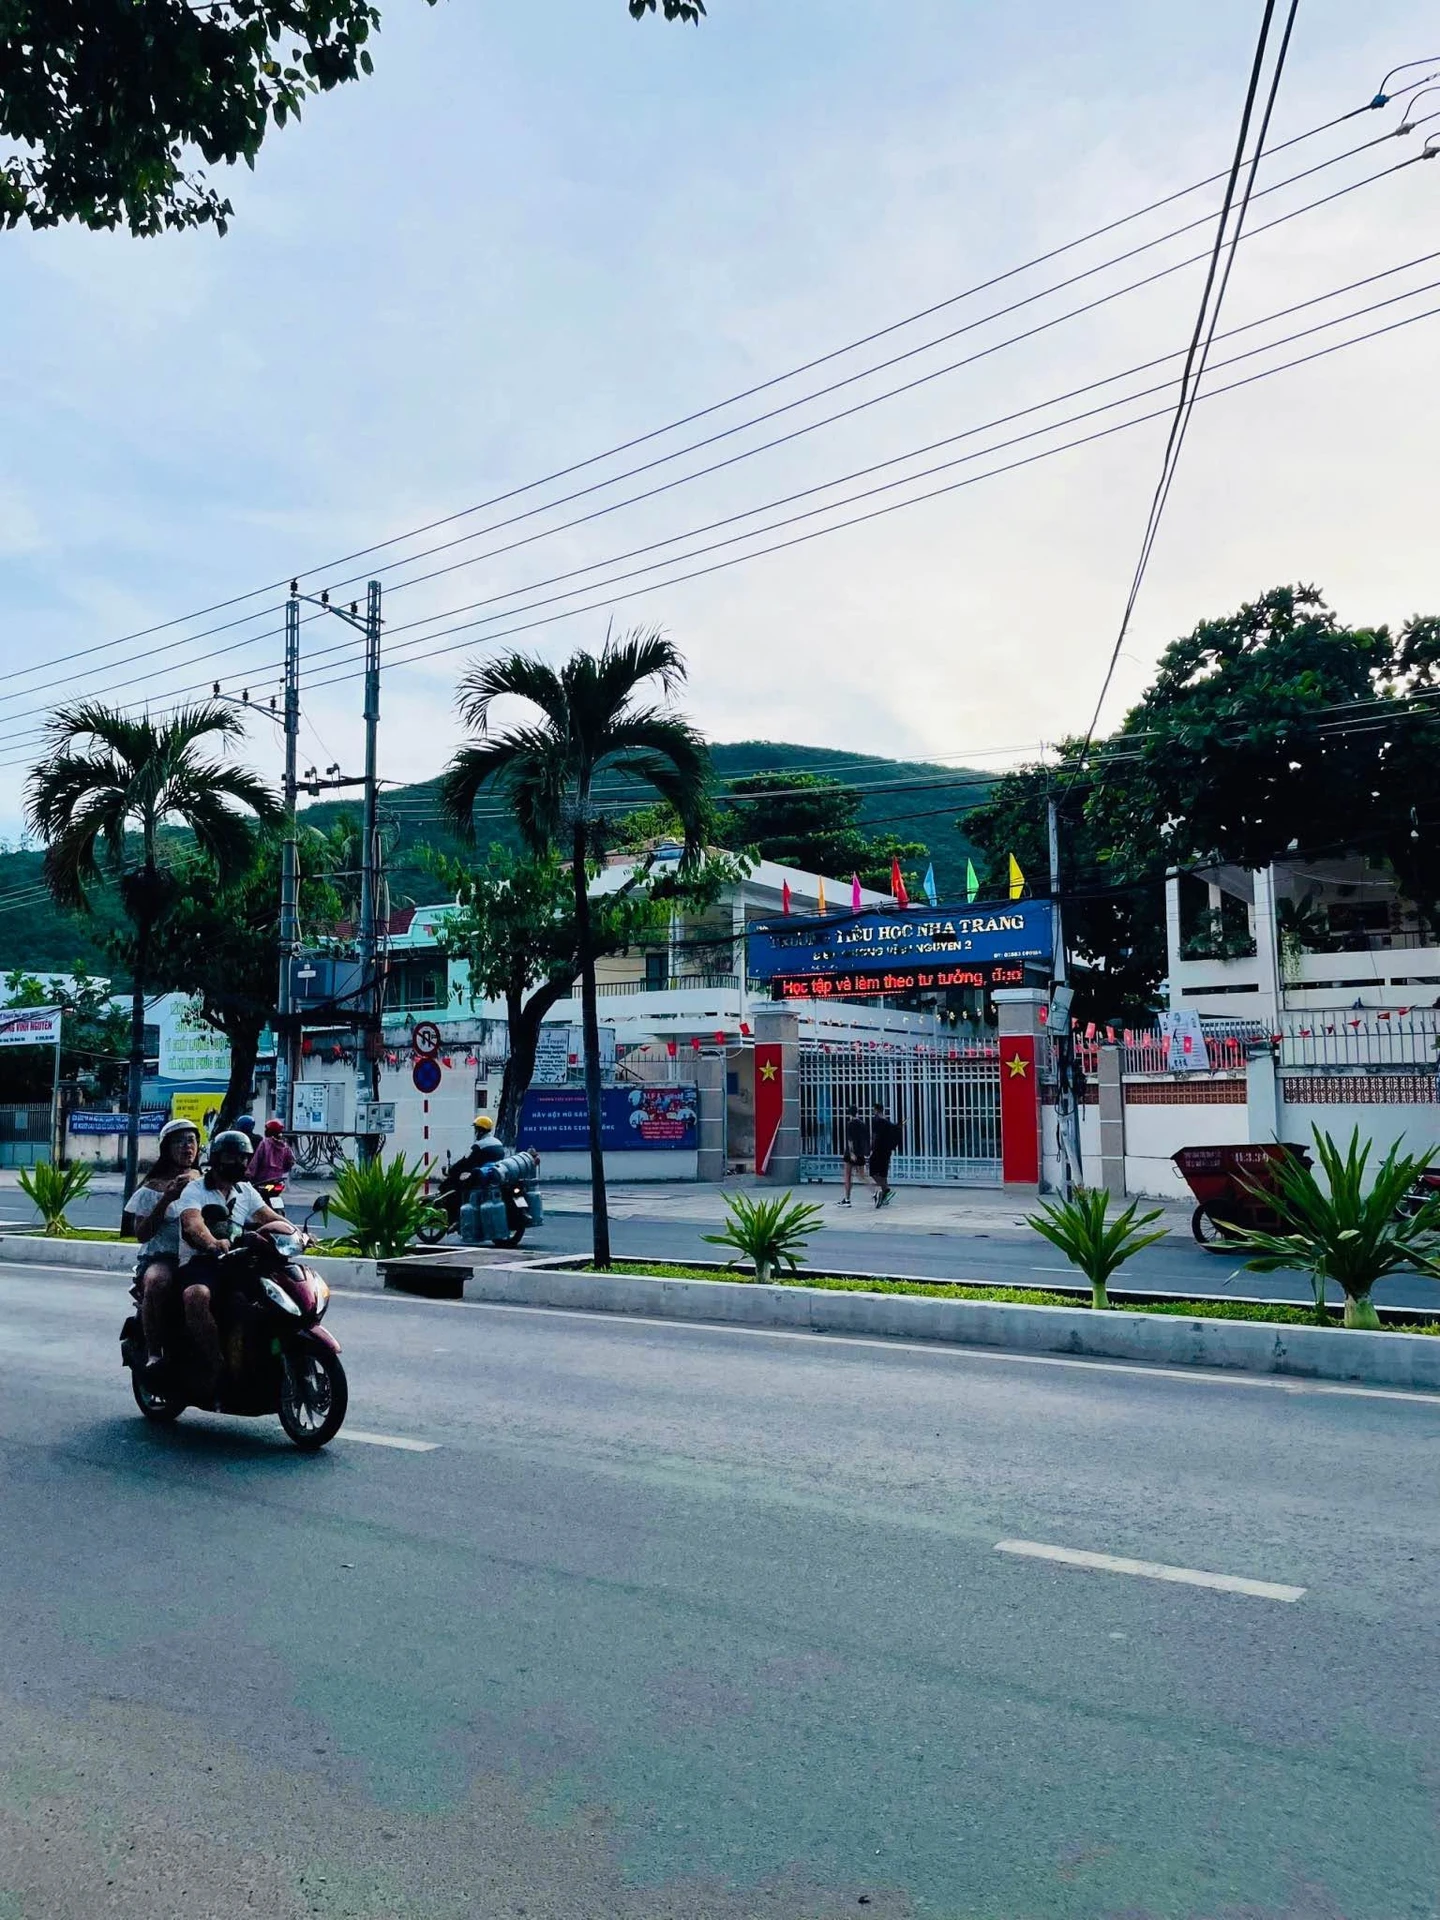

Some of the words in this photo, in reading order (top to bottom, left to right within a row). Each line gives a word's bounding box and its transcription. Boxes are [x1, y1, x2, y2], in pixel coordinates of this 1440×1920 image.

[959, 914, 1024, 934] TRANG
[964, 940, 972, 950] 2
[782, 980, 808, 996] Học
[811, 978, 832, 995] tập
[835, 976, 852, 991] và
[854, 975, 880, 990] làm
[883, 973, 914, 988] theo
[917, 972, 934, 986] tư
